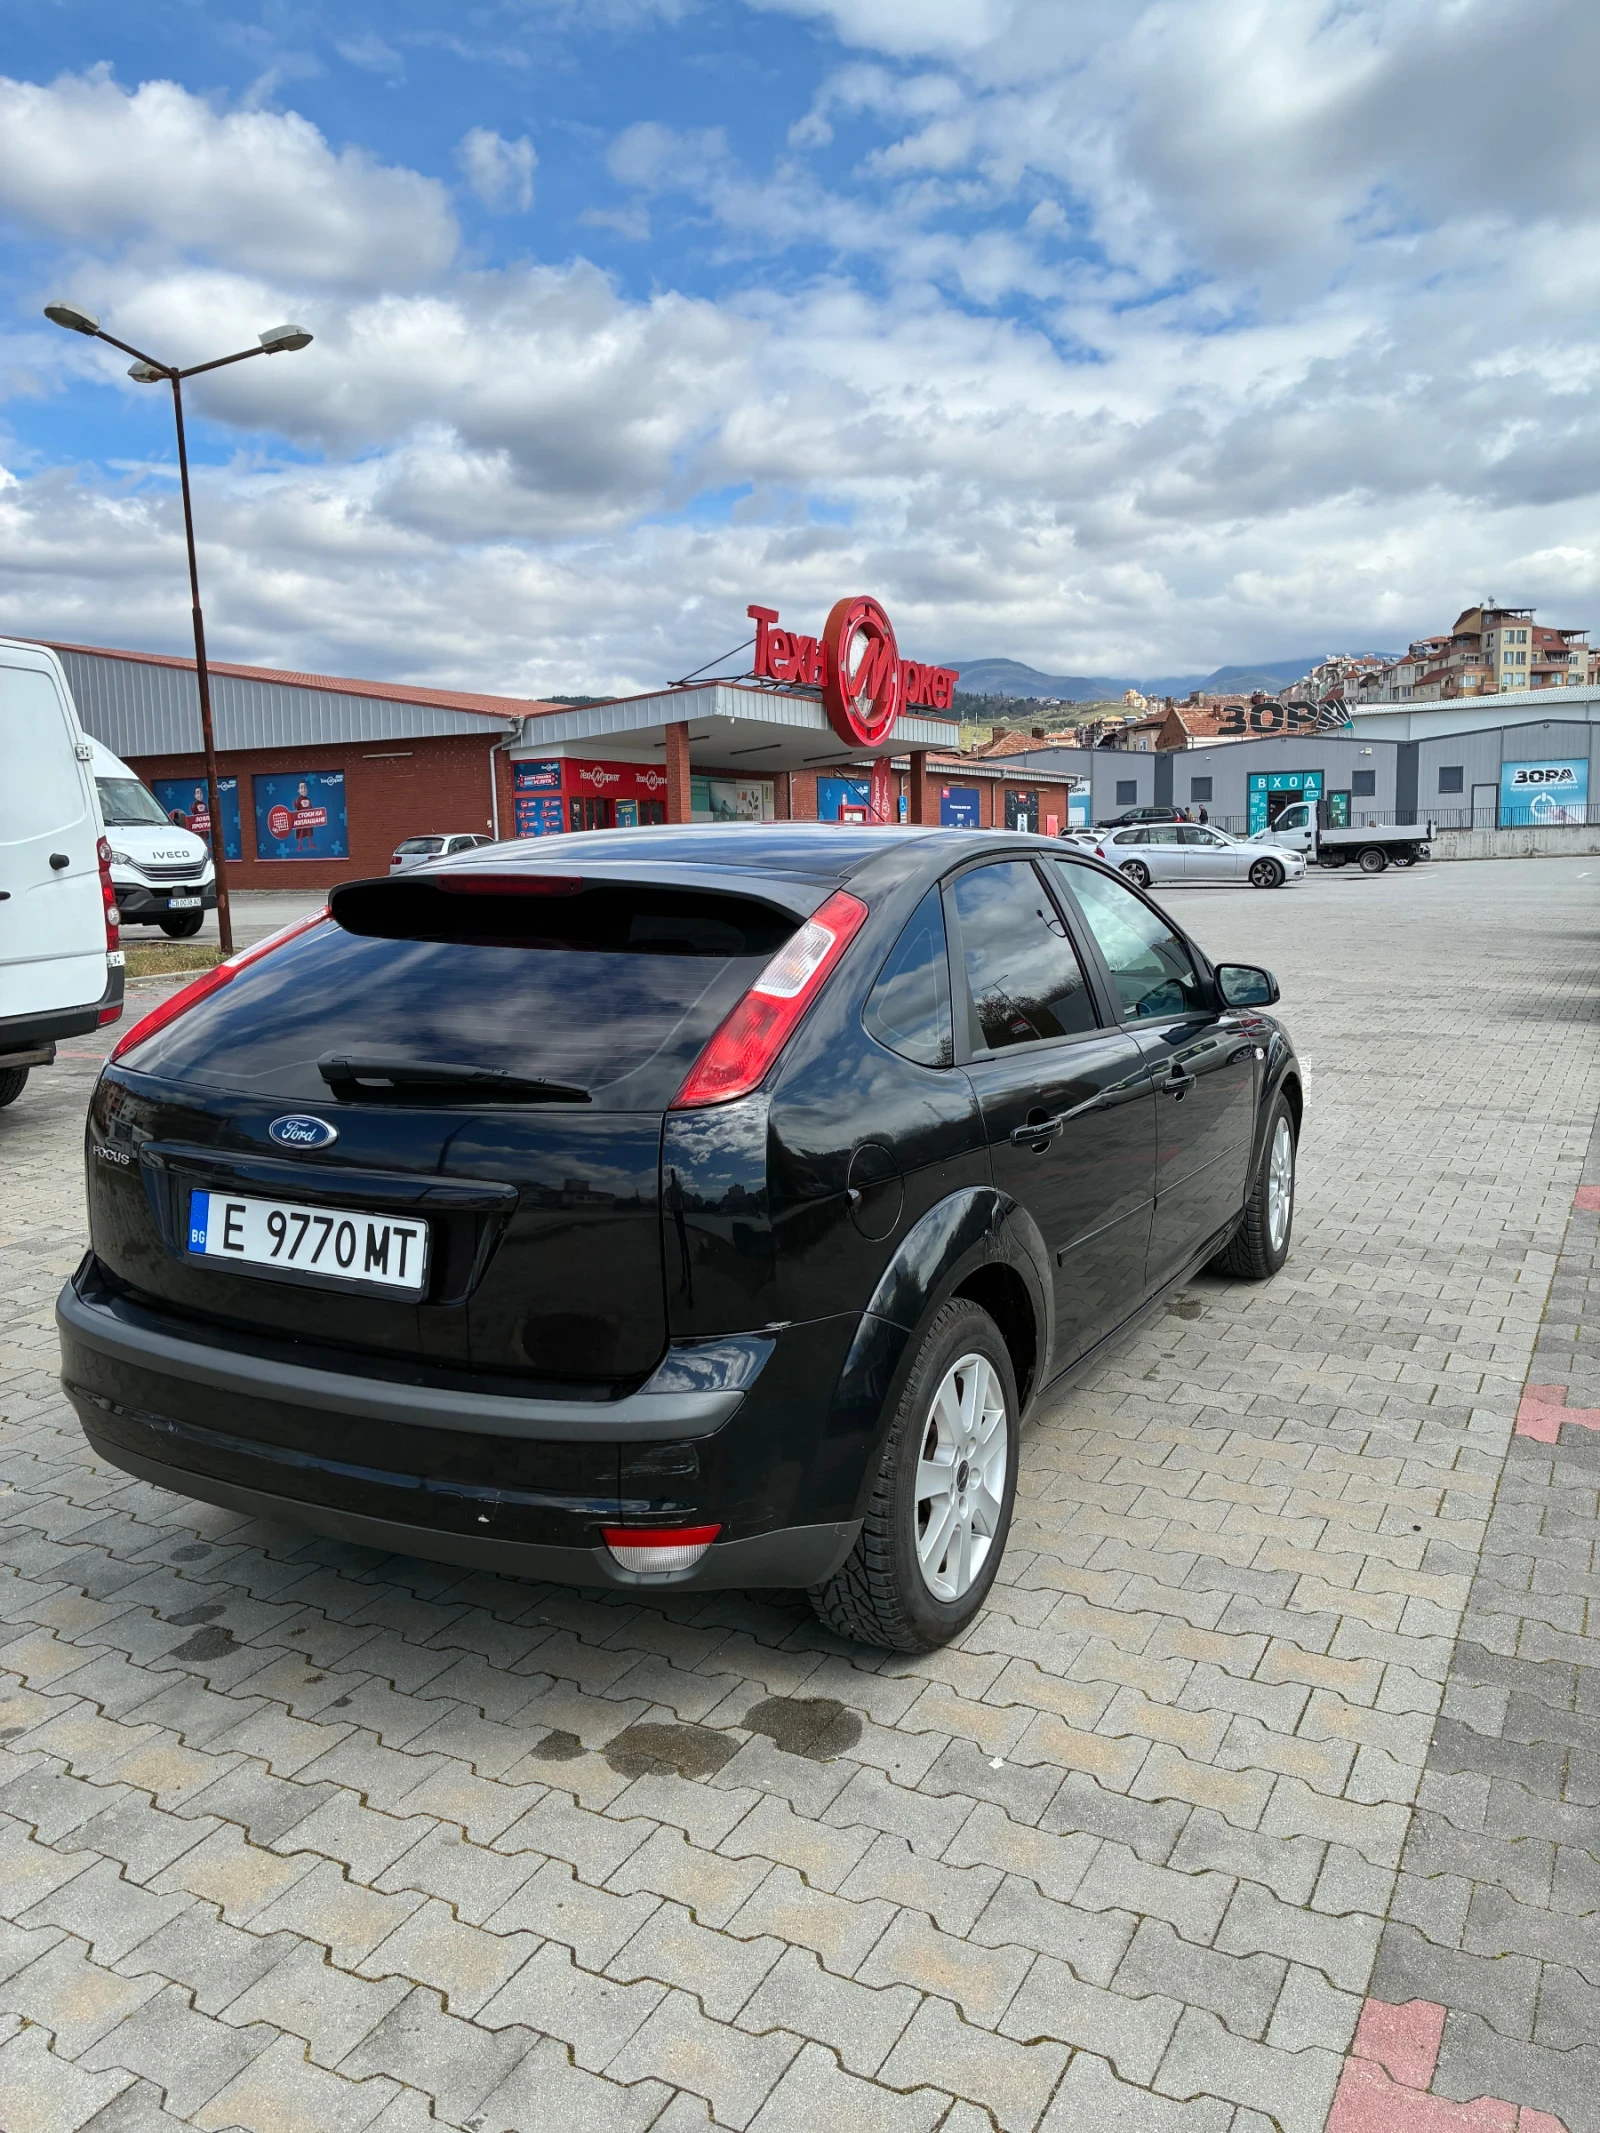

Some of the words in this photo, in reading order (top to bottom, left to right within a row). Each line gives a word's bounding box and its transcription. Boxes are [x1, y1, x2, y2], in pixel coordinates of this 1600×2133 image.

[1217, 699, 1355, 735] ЗОРА
[1258, 775, 1315, 789] ВХОД
[1513, 767, 1576, 784] ЗОРА
[152, 850, 190, 859] IVECO
[281, 1119, 317, 1142] Ford
[92, 1145, 130, 1165] FOCUS
[191, 1228, 206, 1244] BG
[223, 1203, 247, 1252] E
[267, 1210, 356, 1269] 9770
[364, 1222, 418, 1278] MT
